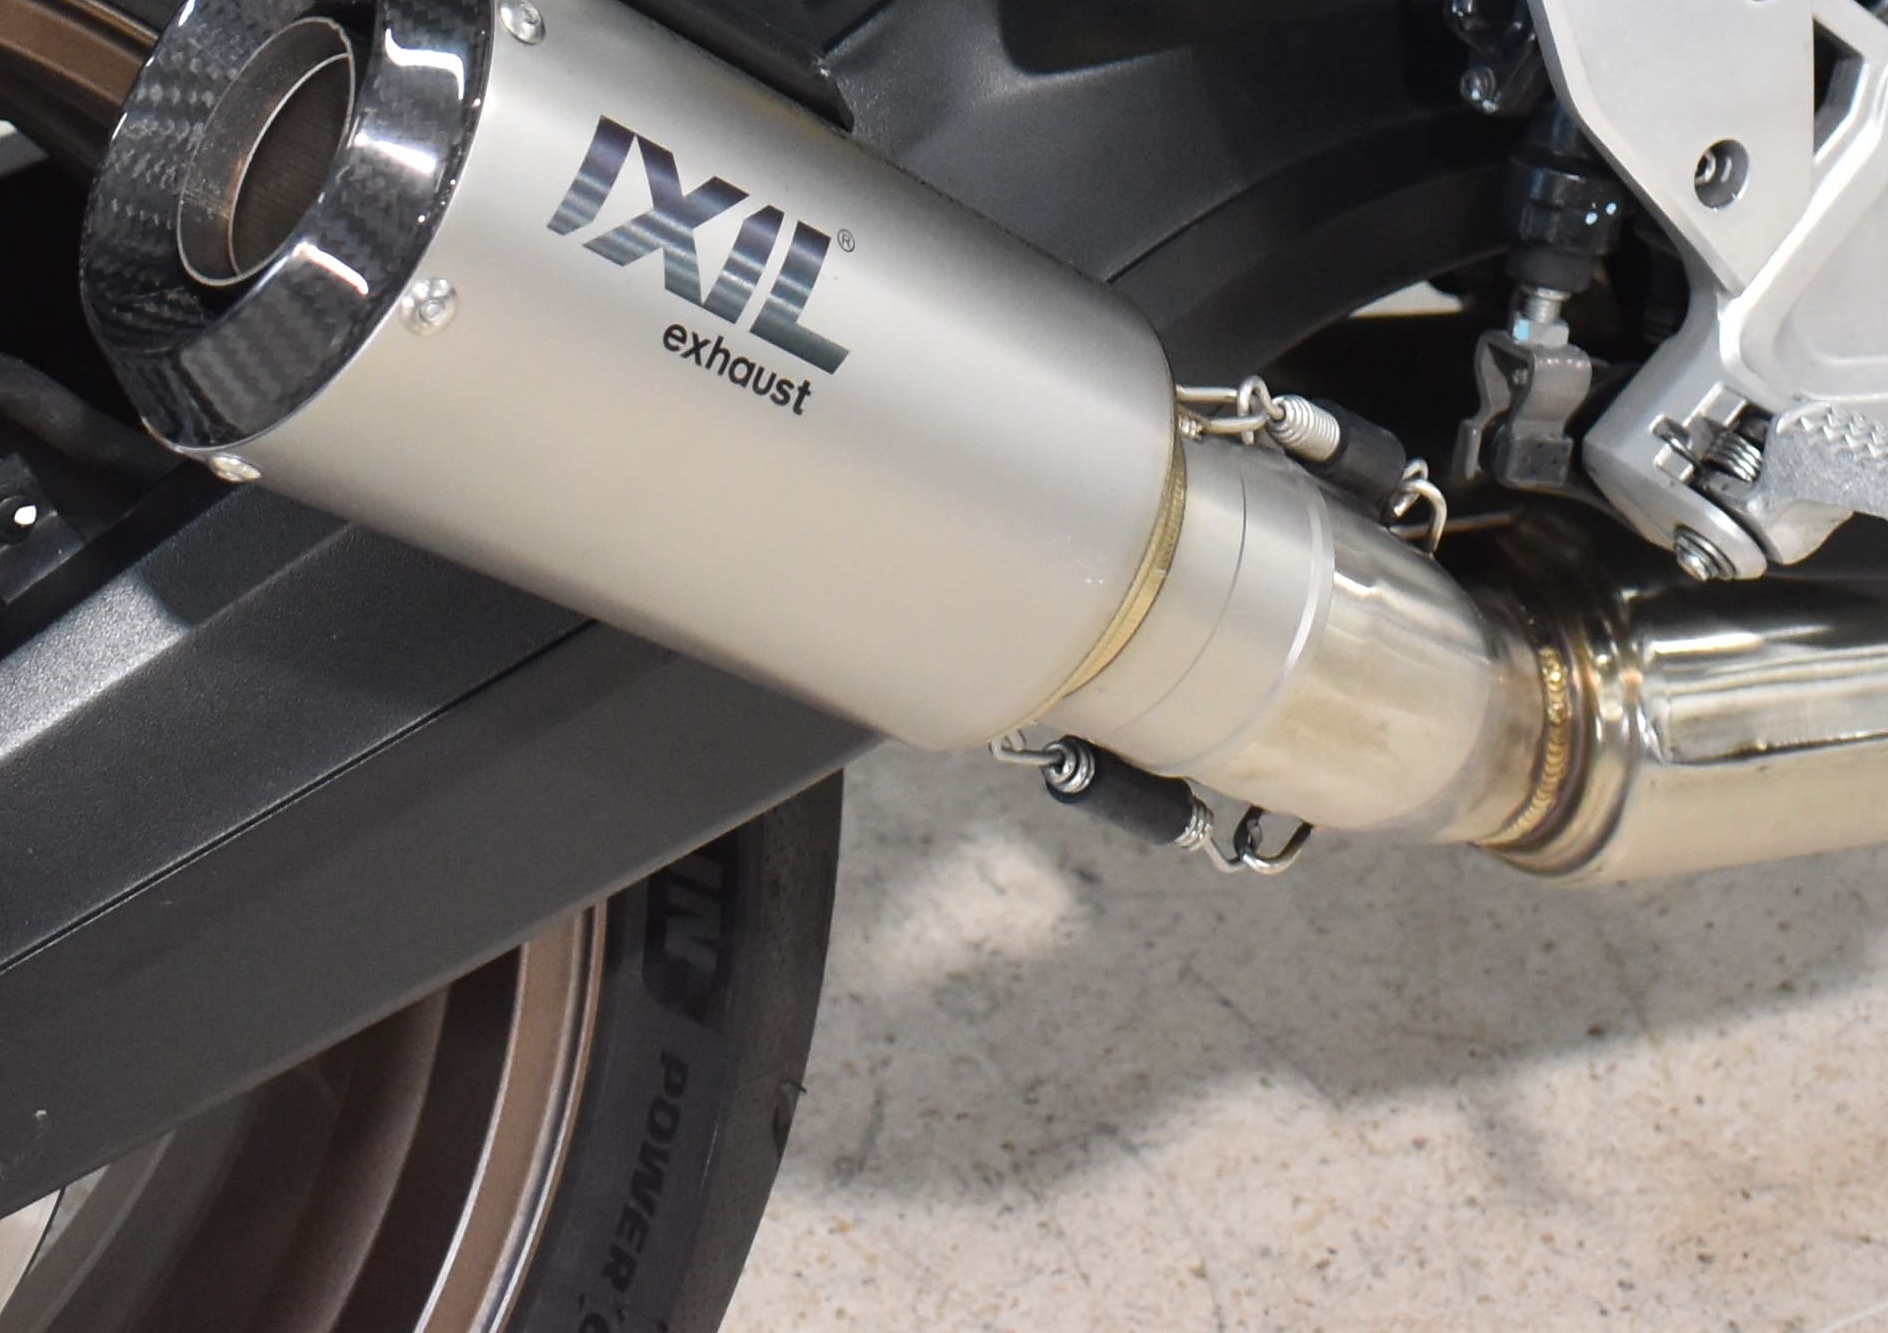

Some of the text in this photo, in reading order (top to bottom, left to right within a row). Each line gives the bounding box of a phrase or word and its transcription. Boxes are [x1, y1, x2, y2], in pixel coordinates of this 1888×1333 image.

[546, 114, 850, 376] IXIL
[662, 323, 812, 416] exhaust
[599, 1049, 690, 1294] POWER
